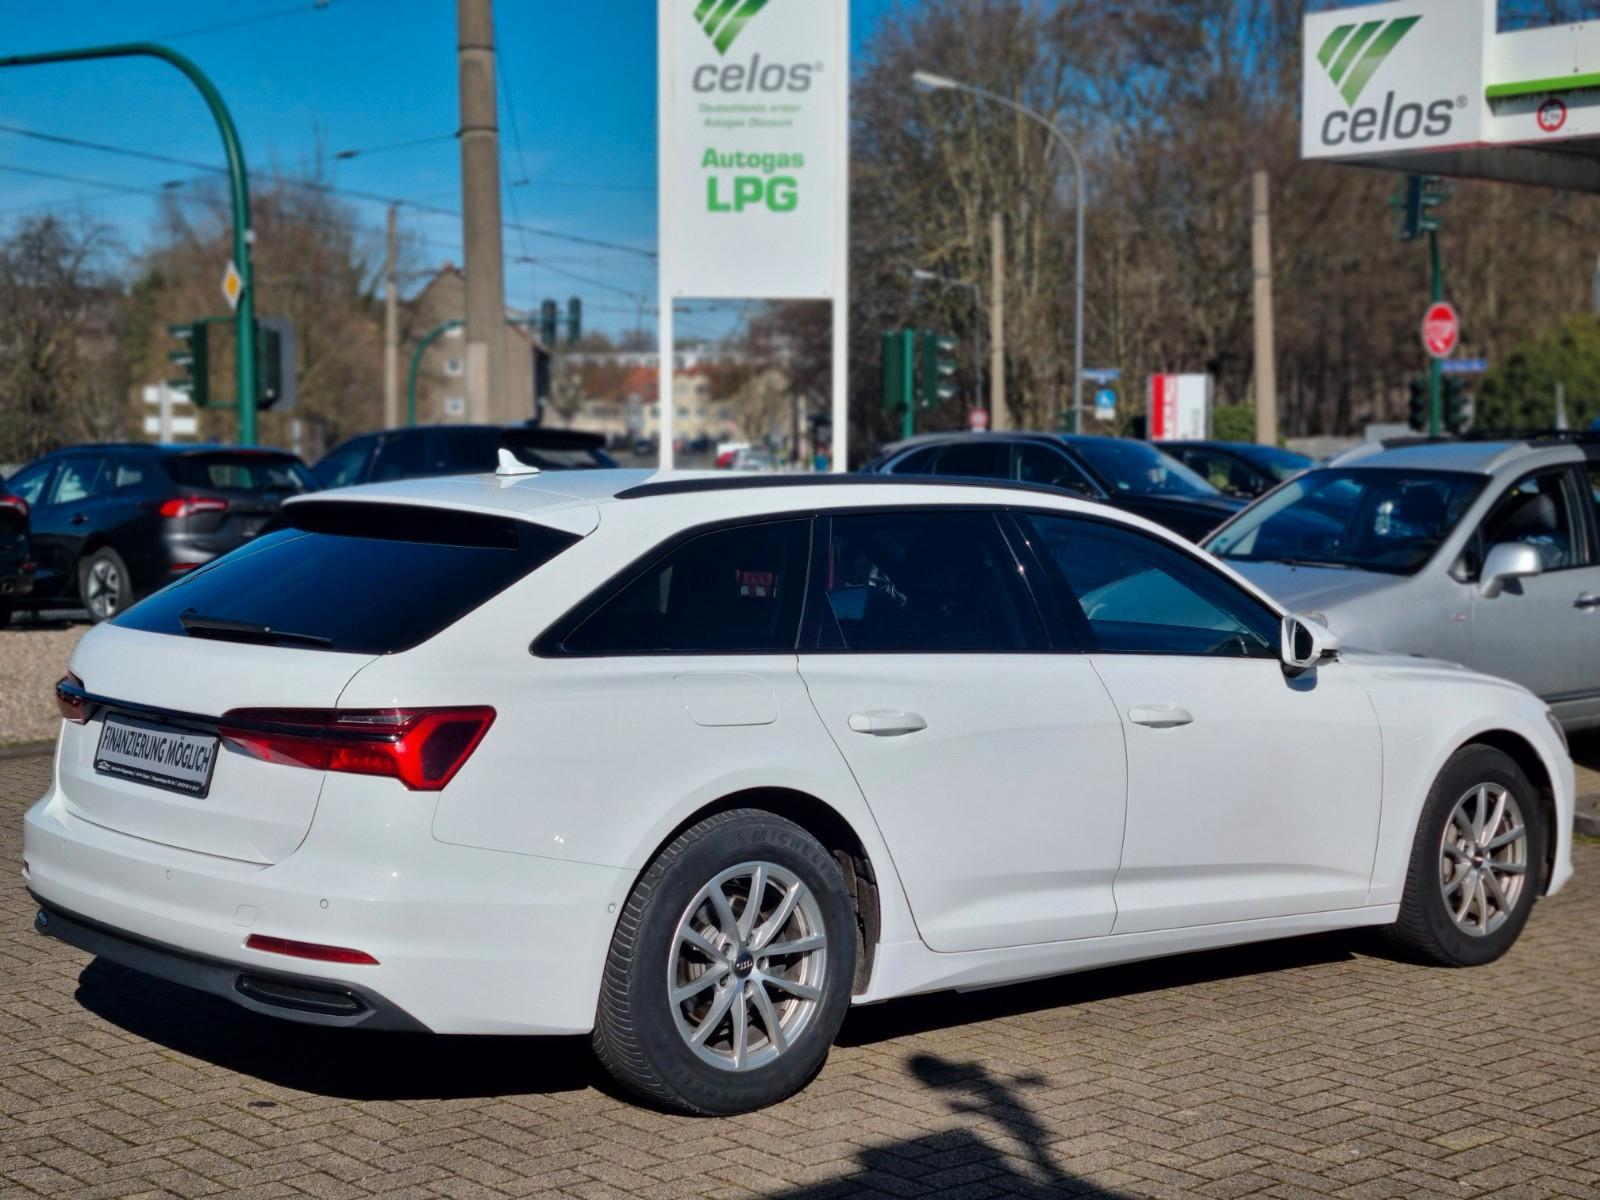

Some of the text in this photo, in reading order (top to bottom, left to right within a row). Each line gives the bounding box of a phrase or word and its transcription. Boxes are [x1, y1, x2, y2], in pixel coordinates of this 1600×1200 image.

[701, 148, 805, 174] Autogas
[706, 176, 798, 213] LPG
[102, 726, 212, 773] FINANZIERUNG MÖGLICH
